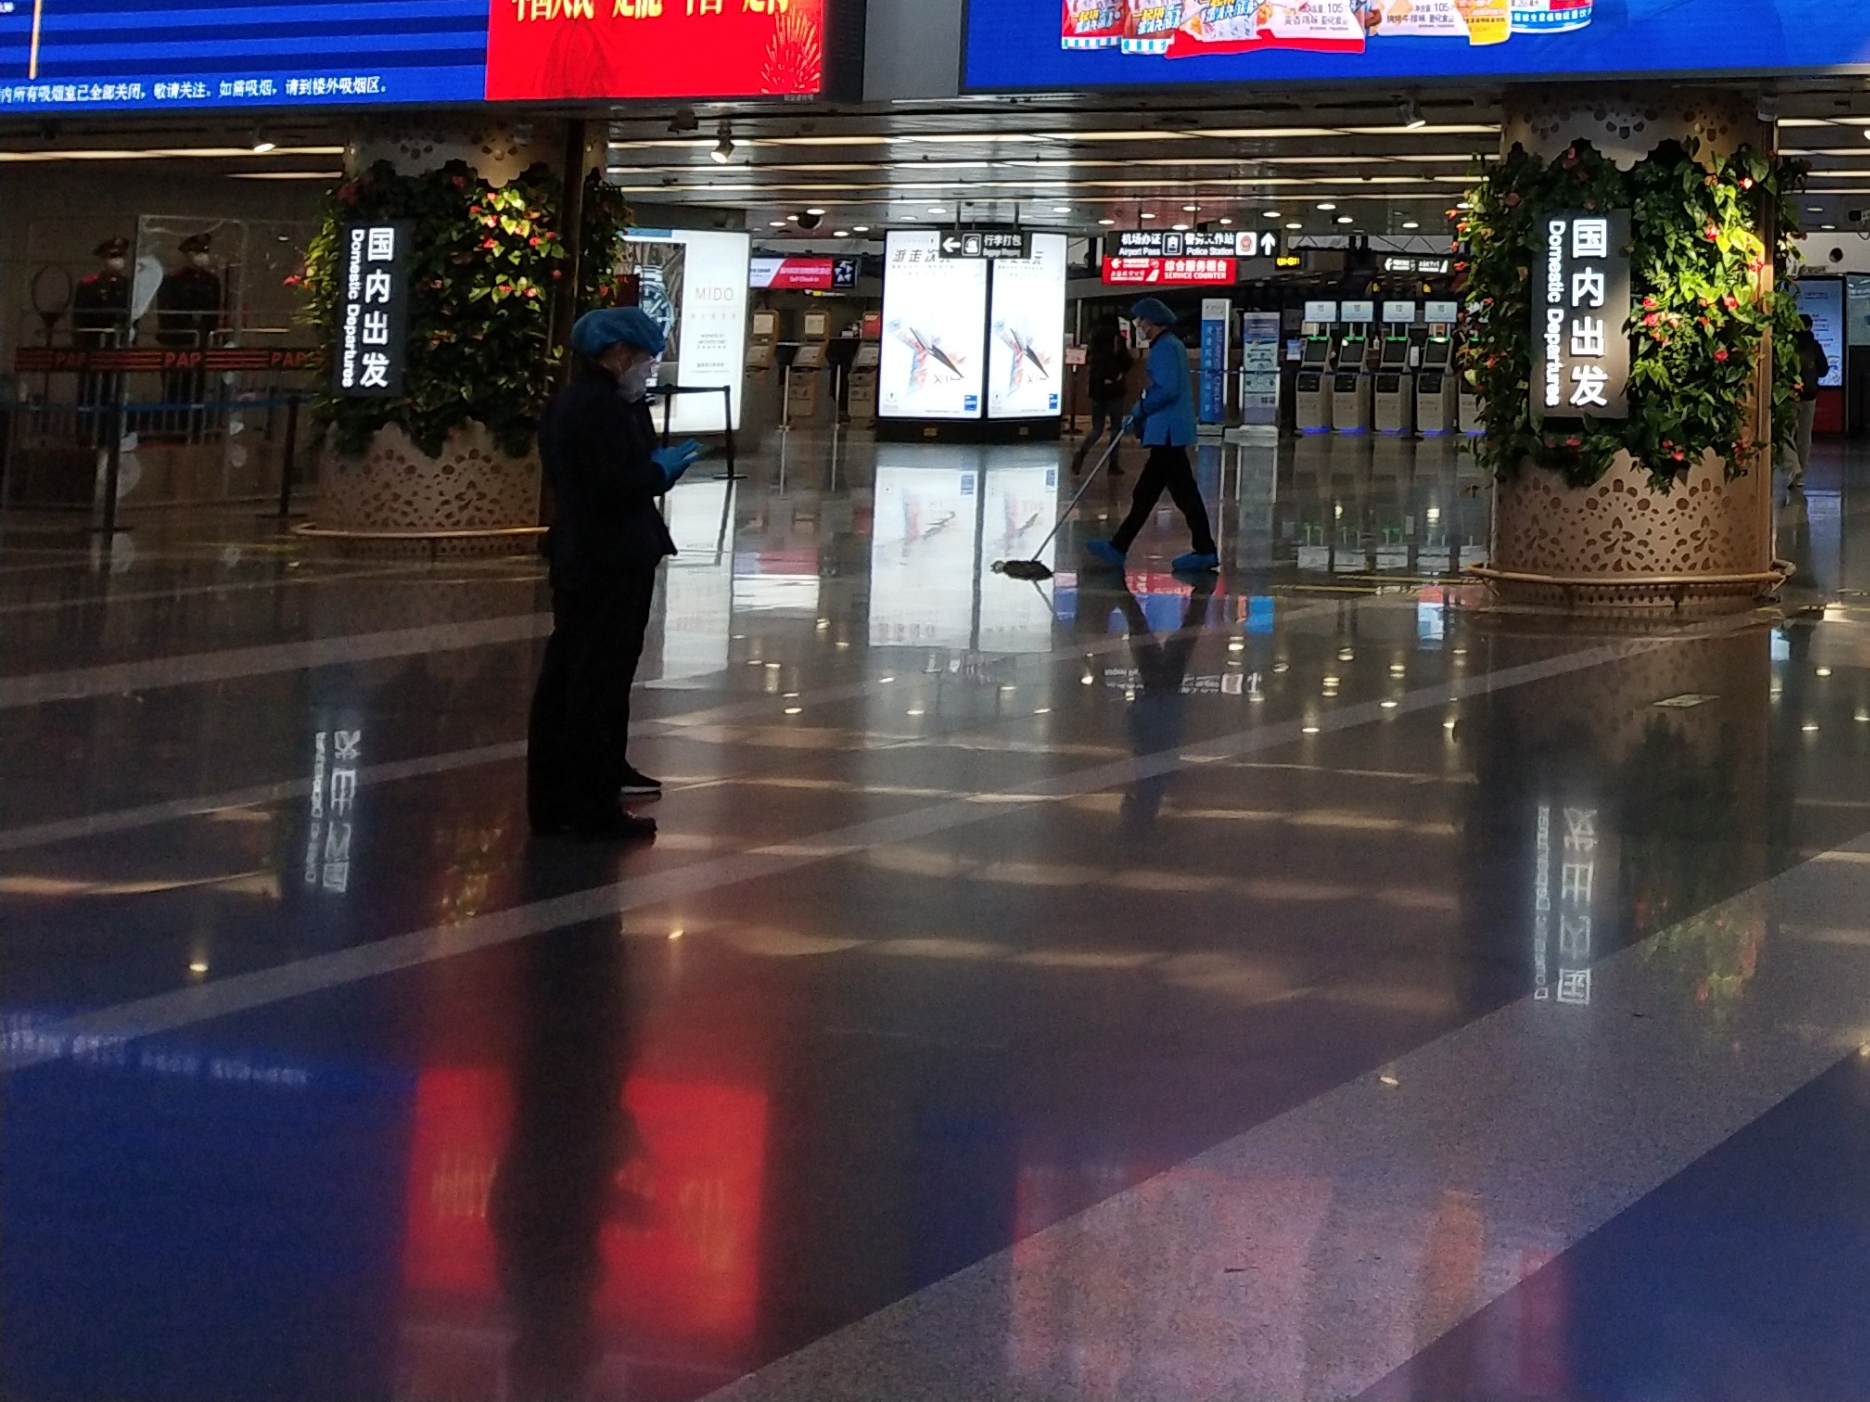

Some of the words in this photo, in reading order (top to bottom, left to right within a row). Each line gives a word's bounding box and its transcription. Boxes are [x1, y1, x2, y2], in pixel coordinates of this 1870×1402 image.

[348, 228, 366, 300] Domestic
[1118, 247, 1143, 257] Airport
[1186, 247, 1208, 256] Police
[1121, 232, 1161, 245] 机场办证
[1164, 272, 1193, 280] SERVICE
[1193, 272, 1227, 280] COUNTER
[1546, 220, 1567, 304] Domestic
[359, 226, 395, 389] 国内出发
[694, 286, 734, 301] MIDO
[1569, 218, 1609, 408] 国内出发
[341, 304, 361, 388] Departures
[1544, 308, 1565, 407] Departures
